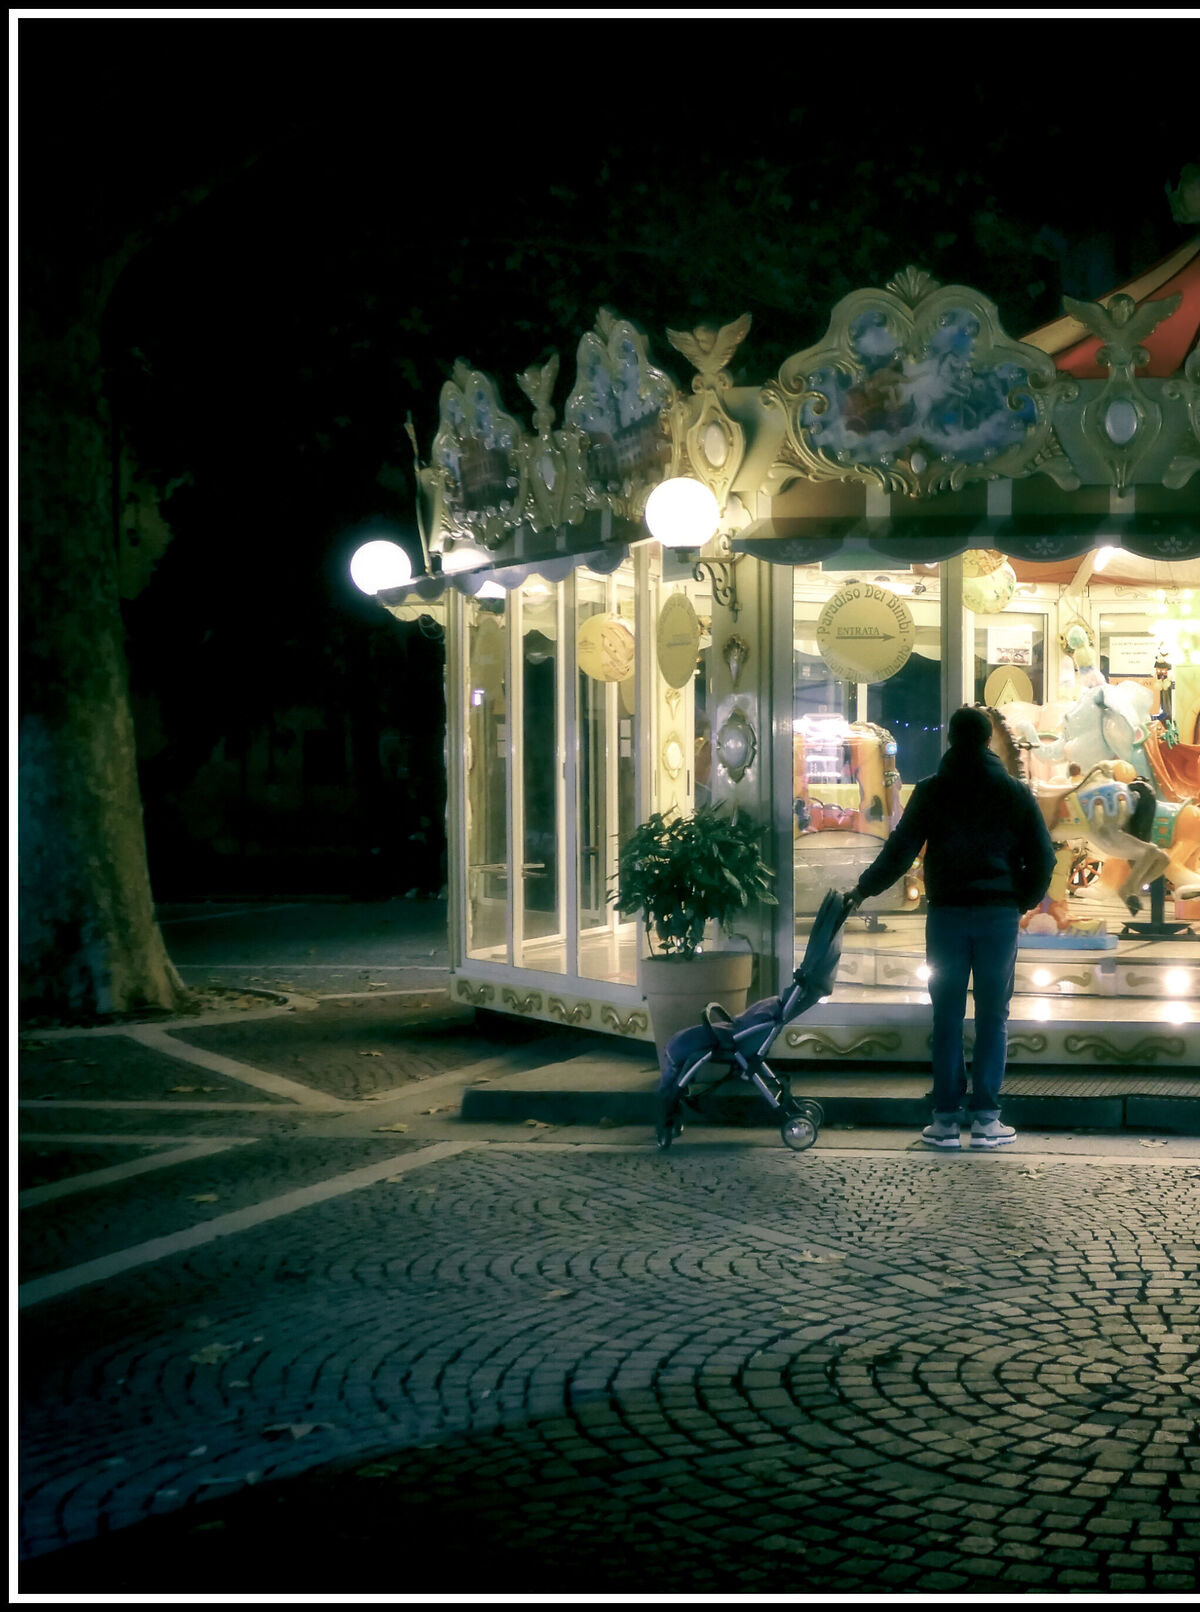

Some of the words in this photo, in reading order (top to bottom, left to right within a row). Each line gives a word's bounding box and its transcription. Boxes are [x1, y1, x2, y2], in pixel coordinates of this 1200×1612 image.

[817, 588, 860, 635] Paradiso
[865, 584, 886, 602] Dei
[886, 594, 912, 634] Bimbi
[837, 626, 880, 636] ENTRATA
